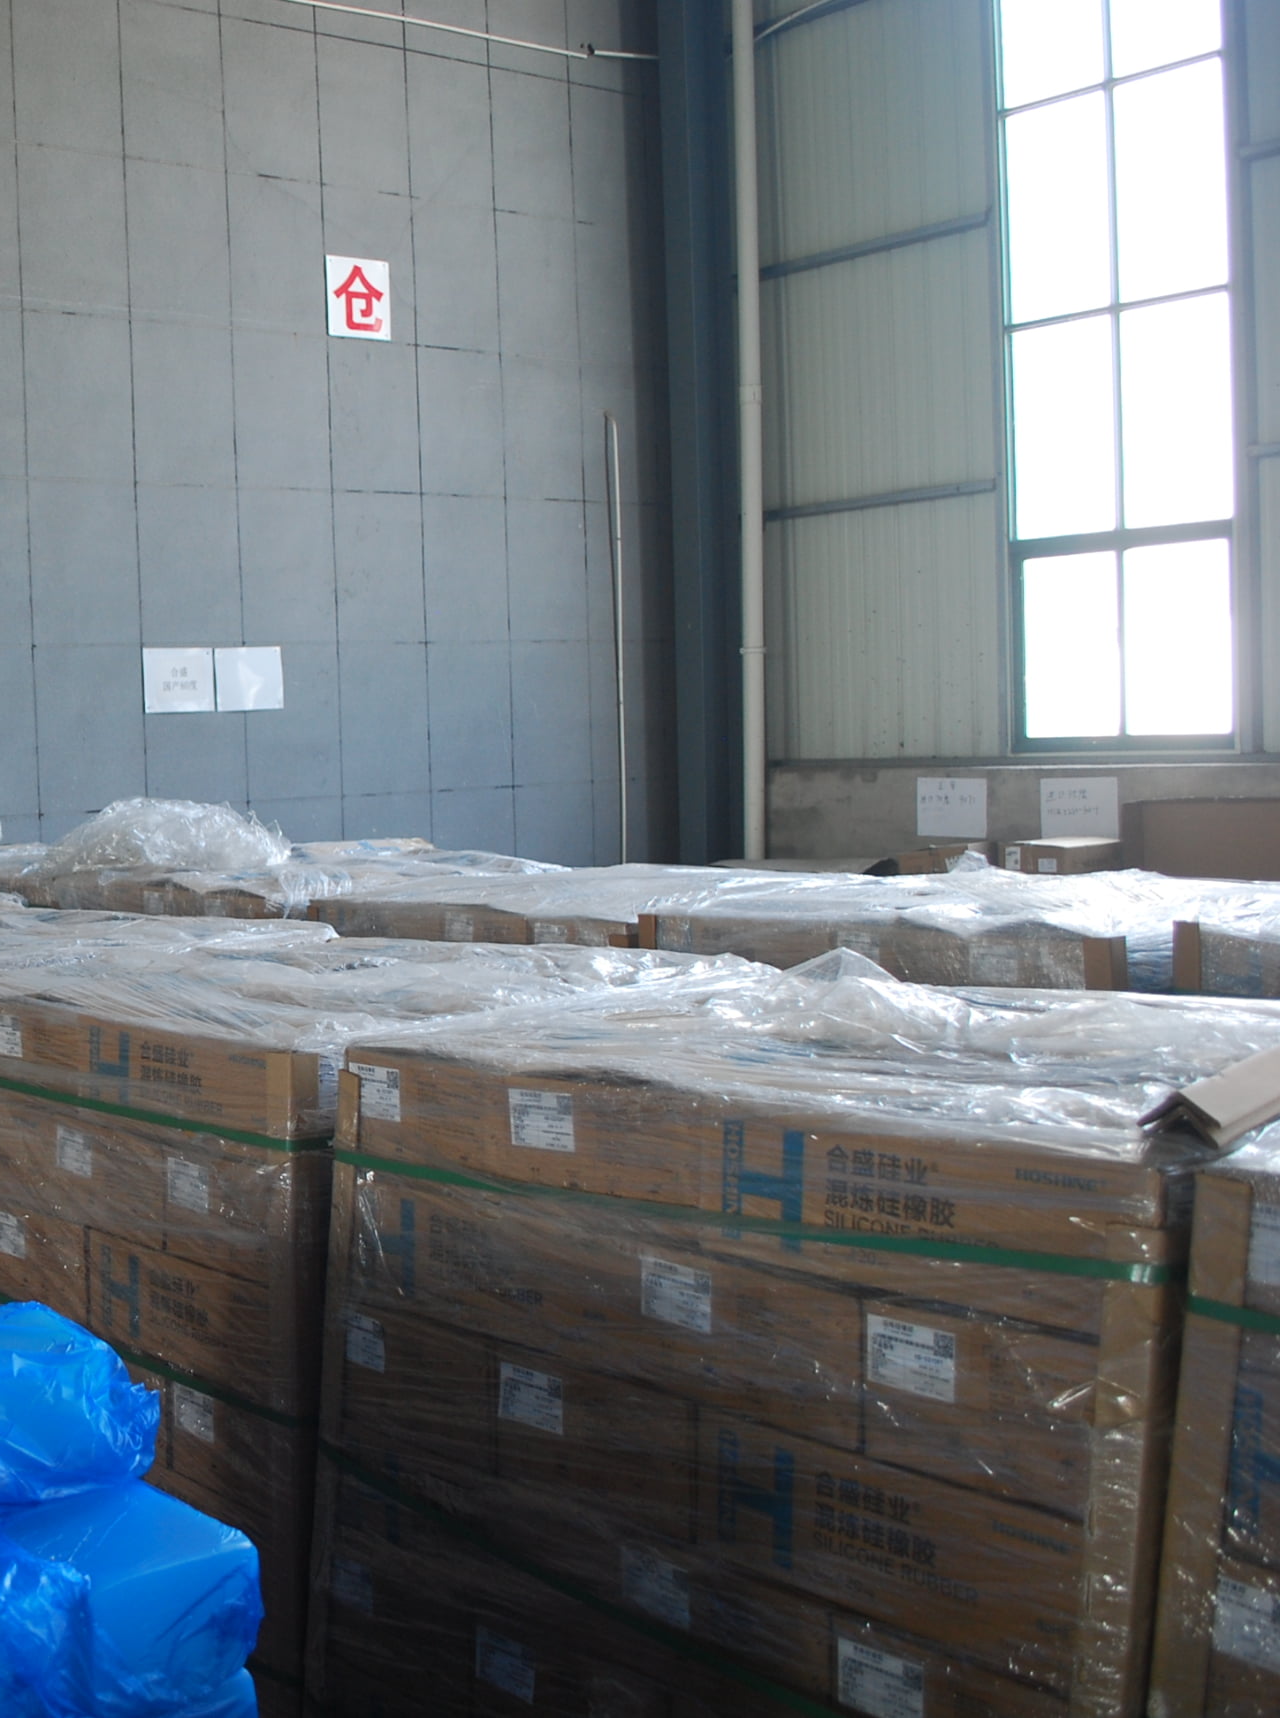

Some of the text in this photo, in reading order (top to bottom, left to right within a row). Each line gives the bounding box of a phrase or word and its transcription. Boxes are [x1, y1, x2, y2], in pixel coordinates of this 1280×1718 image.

[333, 265, 384, 332] 仓
[826, 1144, 928, 1186] 合盛硅业
[826, 1178, 956, 1229] 混炼硅橡胶
